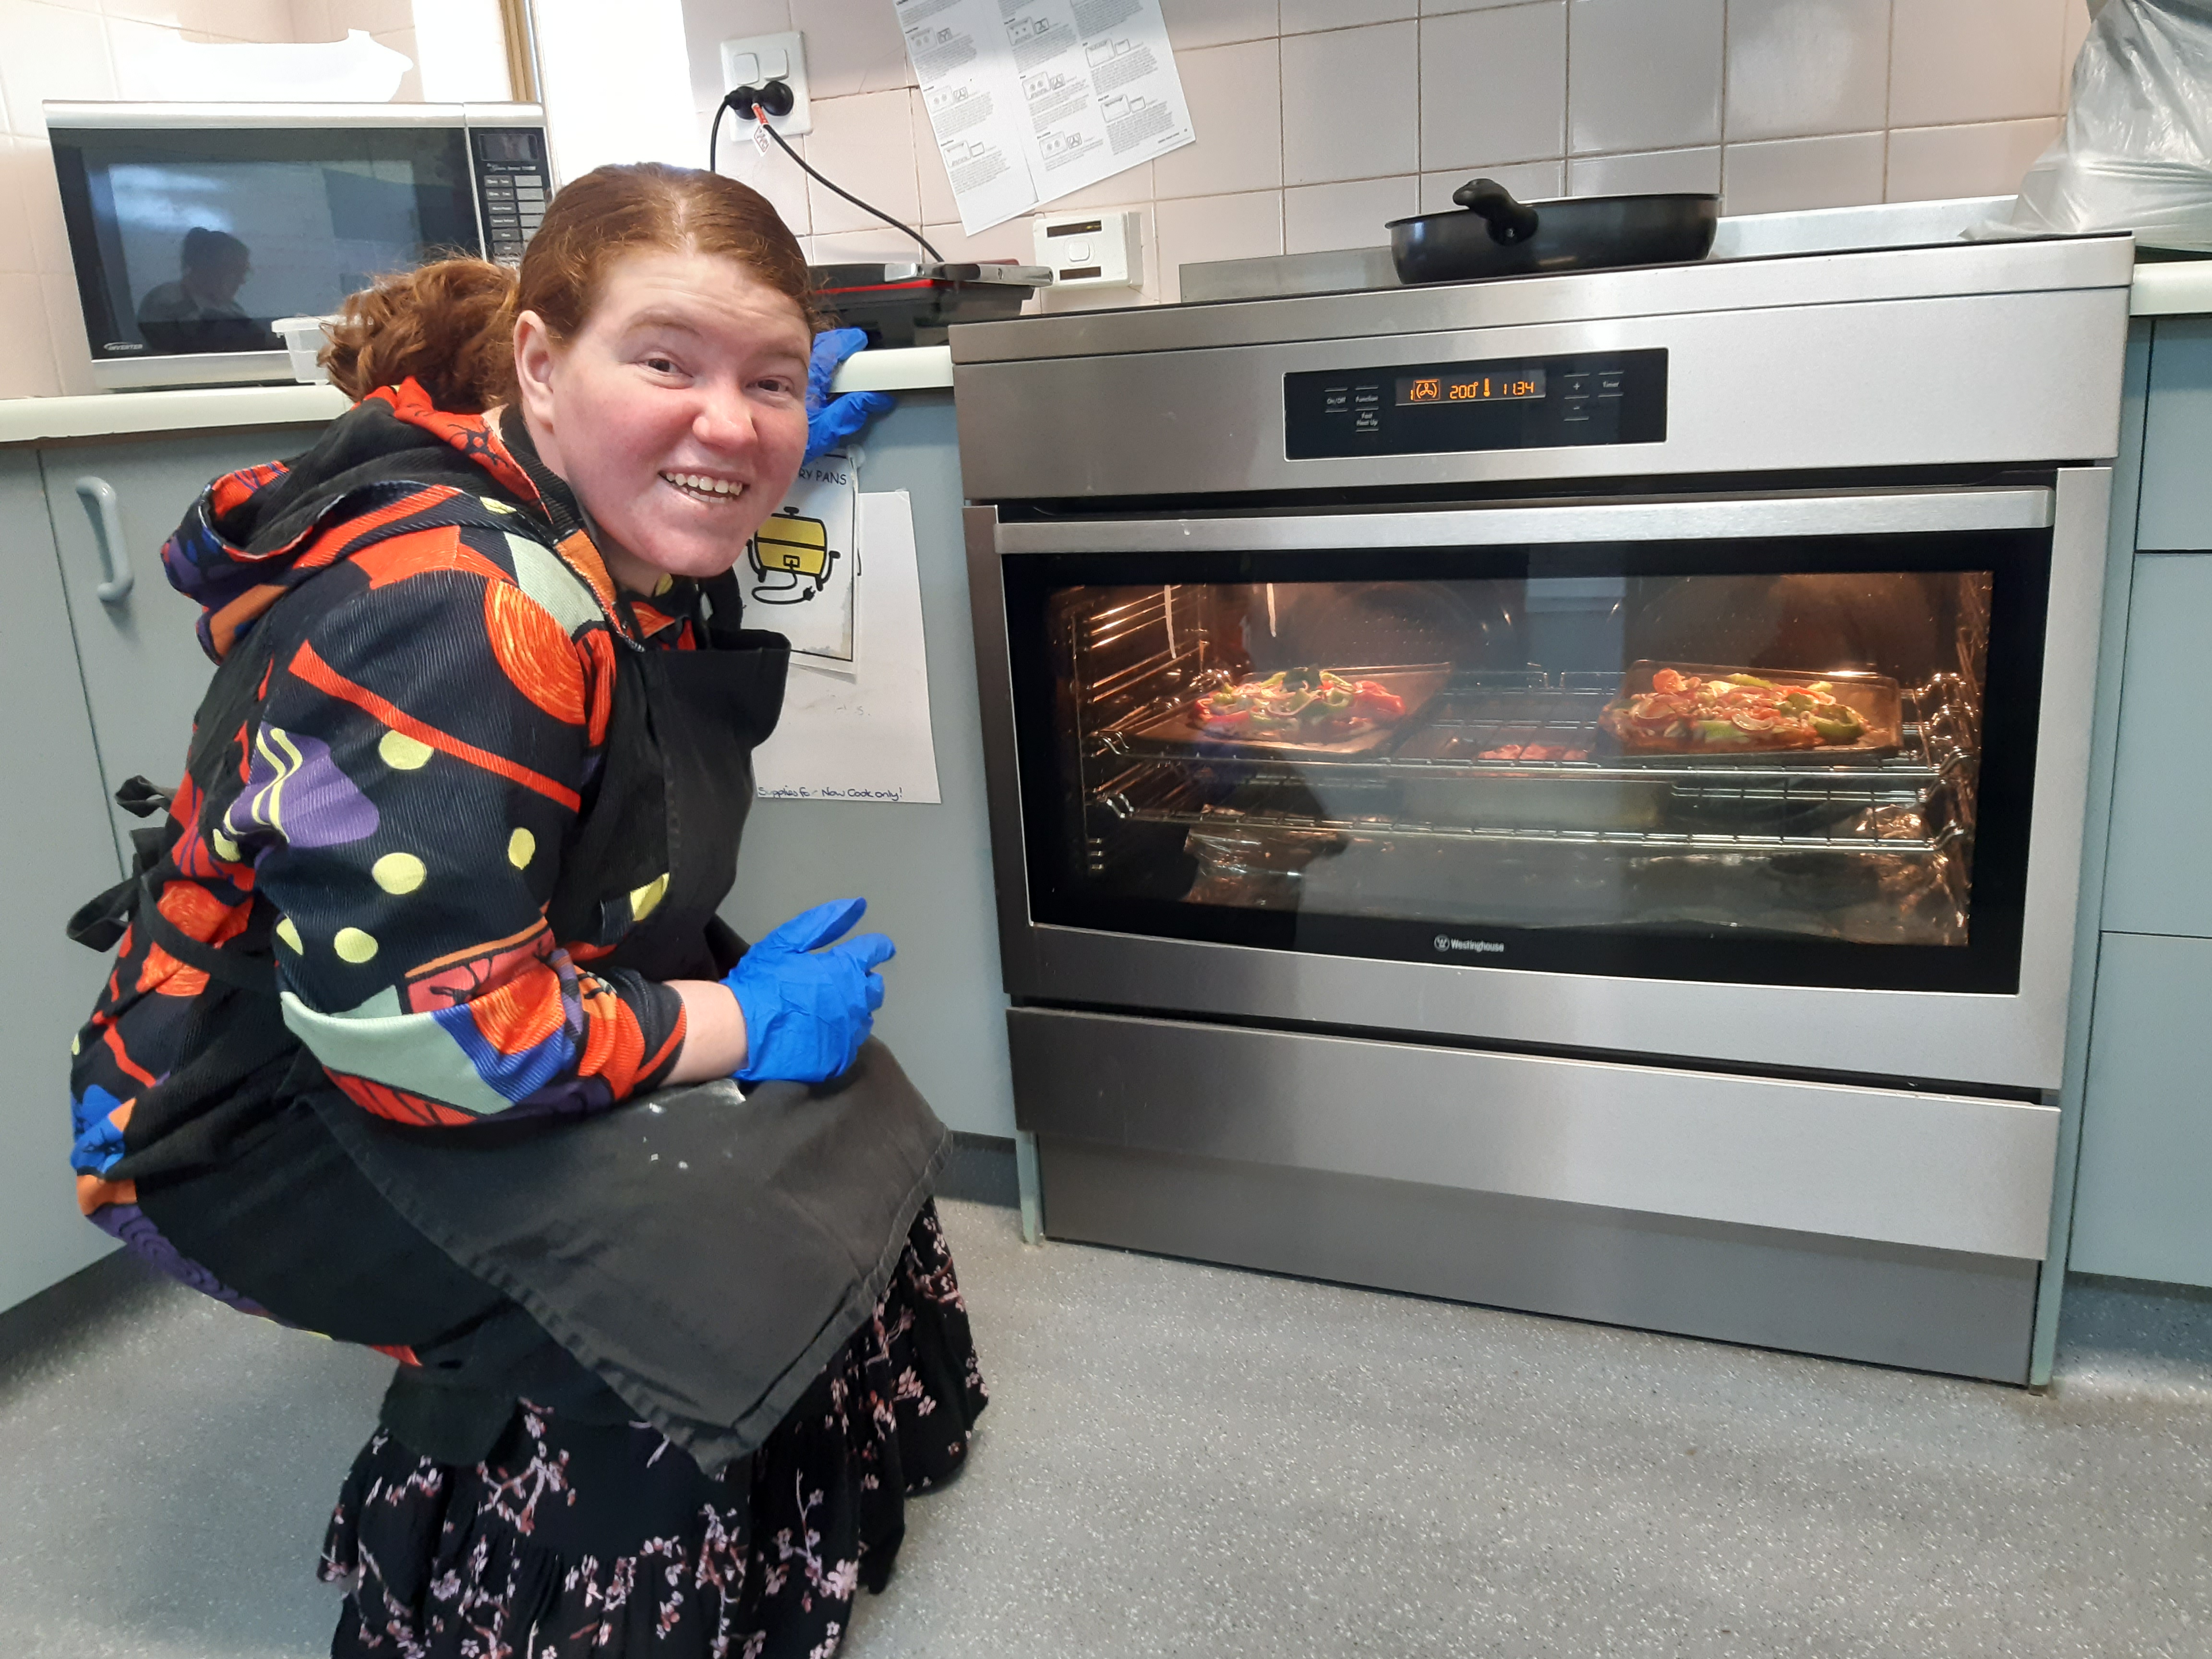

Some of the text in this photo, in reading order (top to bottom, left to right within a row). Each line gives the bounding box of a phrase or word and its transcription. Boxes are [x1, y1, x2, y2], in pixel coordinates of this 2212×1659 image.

[798, 467, 847, 485] RY PANS
[758, 784, 799, 799] Spplies
[821, 787, 845, 797] Now
[847, 788, 874, 798] Cook
[877, 787, 902, 801] only!
[1451, 938, 1504, 953] Westinghouse
